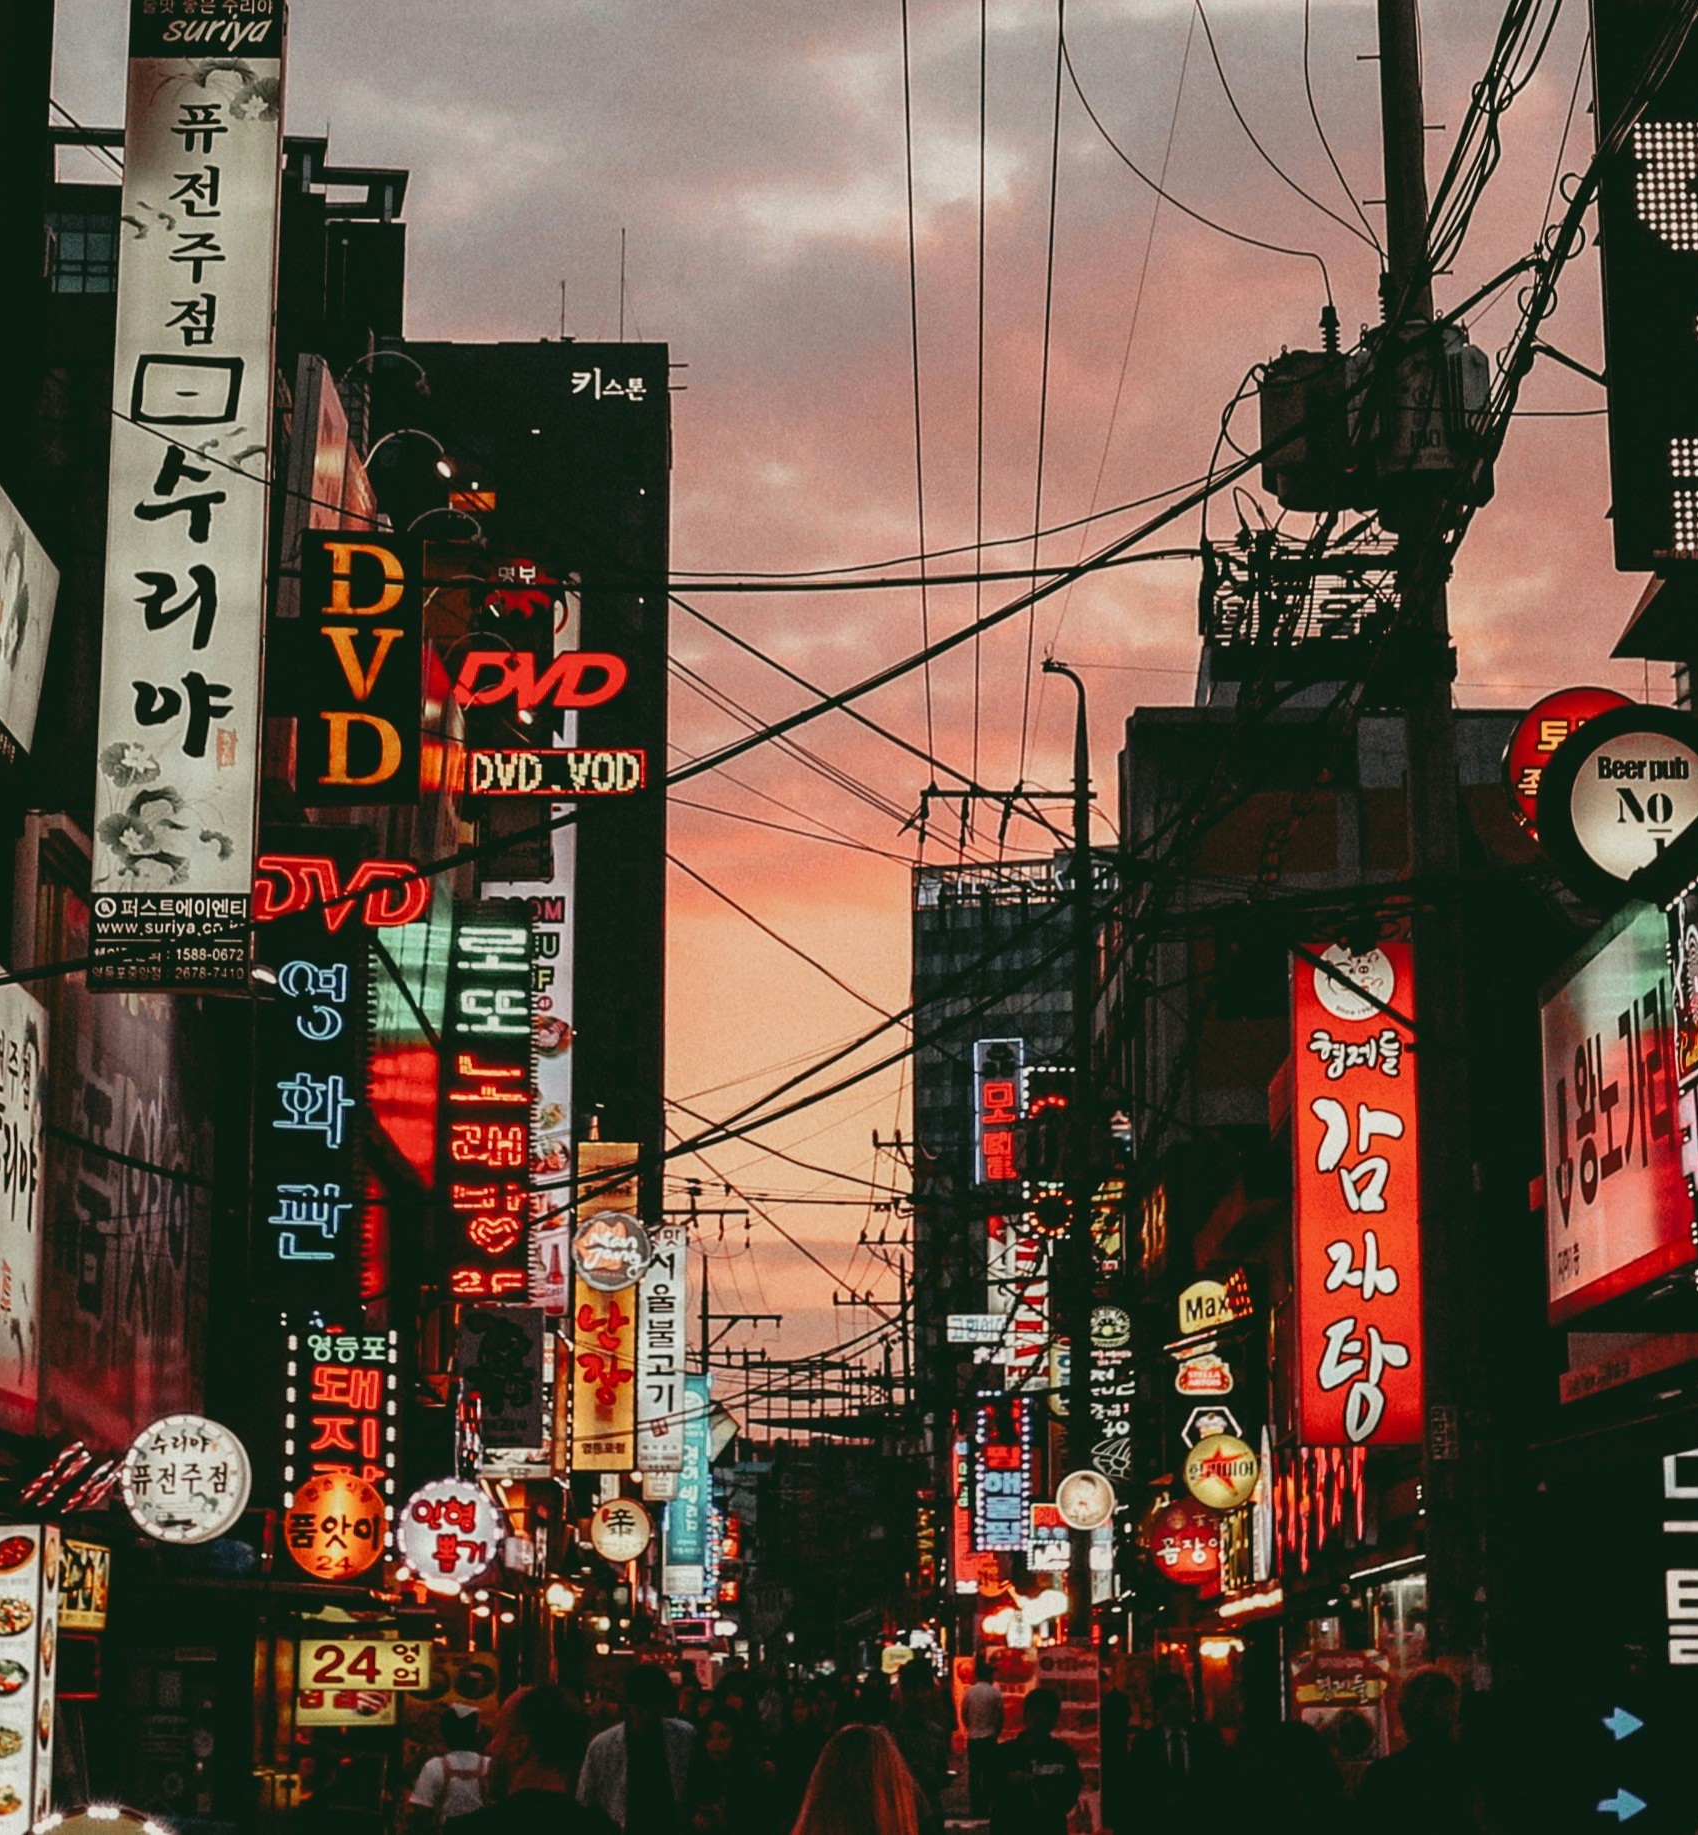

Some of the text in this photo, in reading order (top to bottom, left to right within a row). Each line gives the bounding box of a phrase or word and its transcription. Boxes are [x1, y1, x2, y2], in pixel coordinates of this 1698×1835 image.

[163, 14, 273, 52] suriya
[165, 103, 229, 346] 퓨전주점
[571, 367, 647, 402] 키스톤
[132, 445, 233, 759] 수리야
[316, 541, 405, 787] DVD
[451, 649, 629, 709] DVD
[1597, 756, 1690, 782] Beer pub
[120, 897, 247, 919] 퍼스트에이엔티
[254, 854, 431, 933] DVD
[174, 964, 244, 980] 2678-7410
[176, 947, 245, 962] 1588-0672
[1307, 1028, 1402, 1081] 형제들
[1310, 1097, 1409, 1443] 감자탕
[1185, 1295, 1229, 1323] Max
[307, 1334, 387, 1362] 영등포
[647, 1252, 678, 1414] 서울불고기
[576, 1300, 635, 1407] 난장
[150, 1436, 210, 1453] 수리야
[131, 1461, 229, 1497] 퓨전주점
[289, 1512, 380, 1551] 품앗이
[315, 1554, 353, 1572] 24
[313, 1644, 382, 1684] 24
